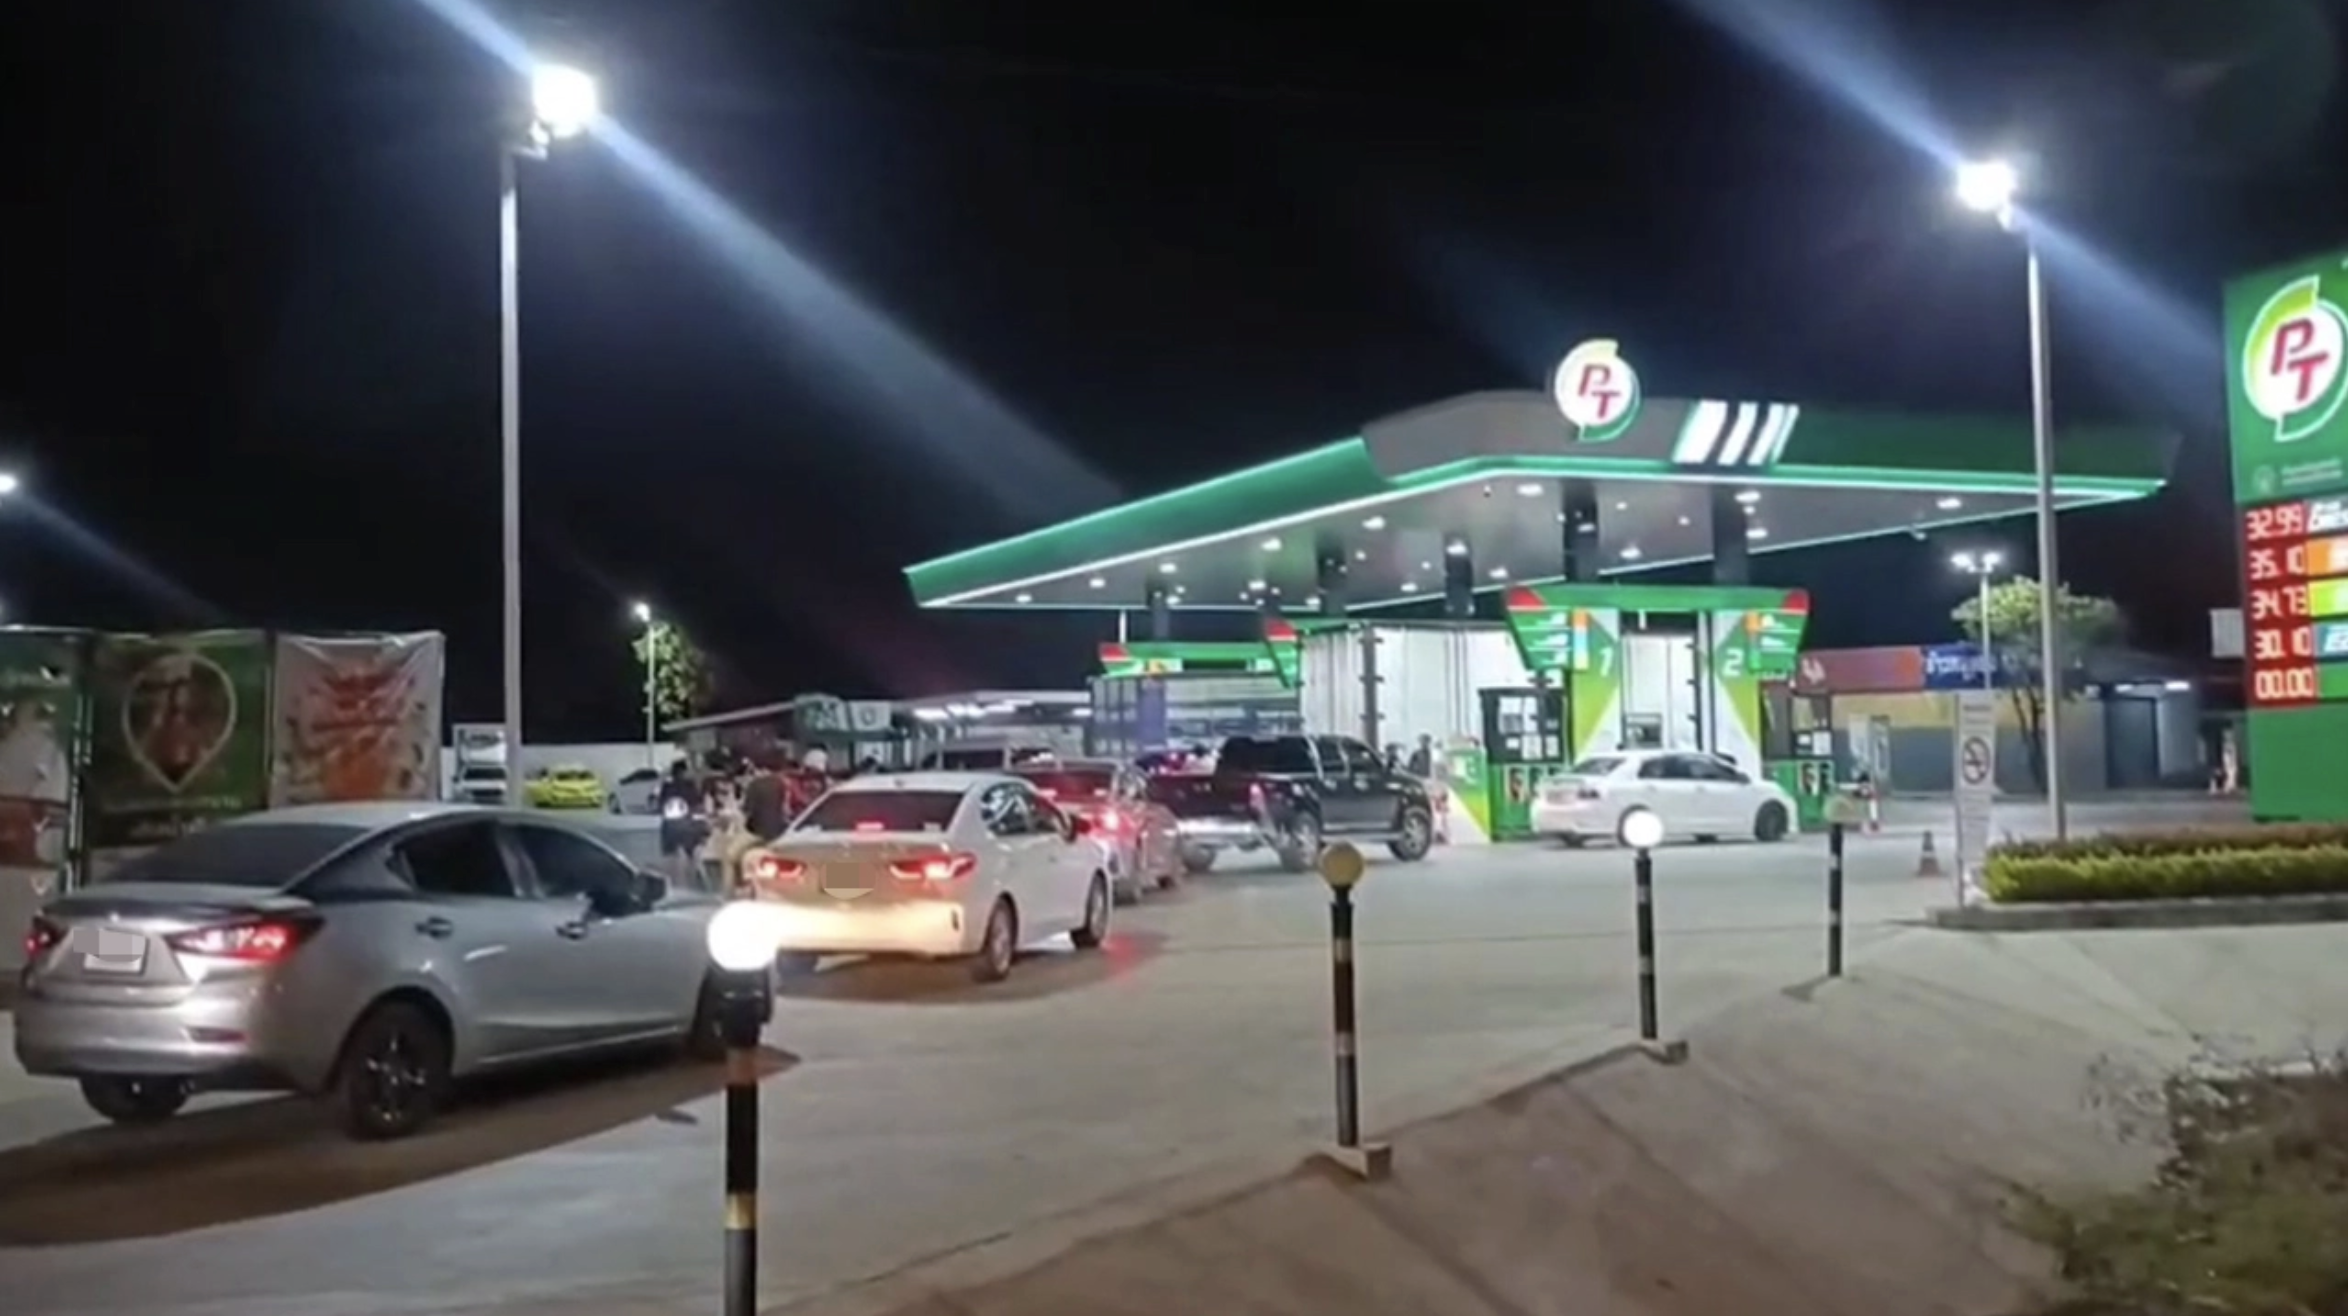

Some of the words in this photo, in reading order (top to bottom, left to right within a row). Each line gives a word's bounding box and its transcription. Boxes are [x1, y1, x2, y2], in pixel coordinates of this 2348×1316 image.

[2270, 317, 2330, 402] PT
[1578, 363, 1621, 419] PT
[2246, 503, 2304, 540] 32.99
[1600, 649, 1613, 677] 1
[1722, 649, 1744, 677] 2
[2255, 667, 2315, 700] 00.00
